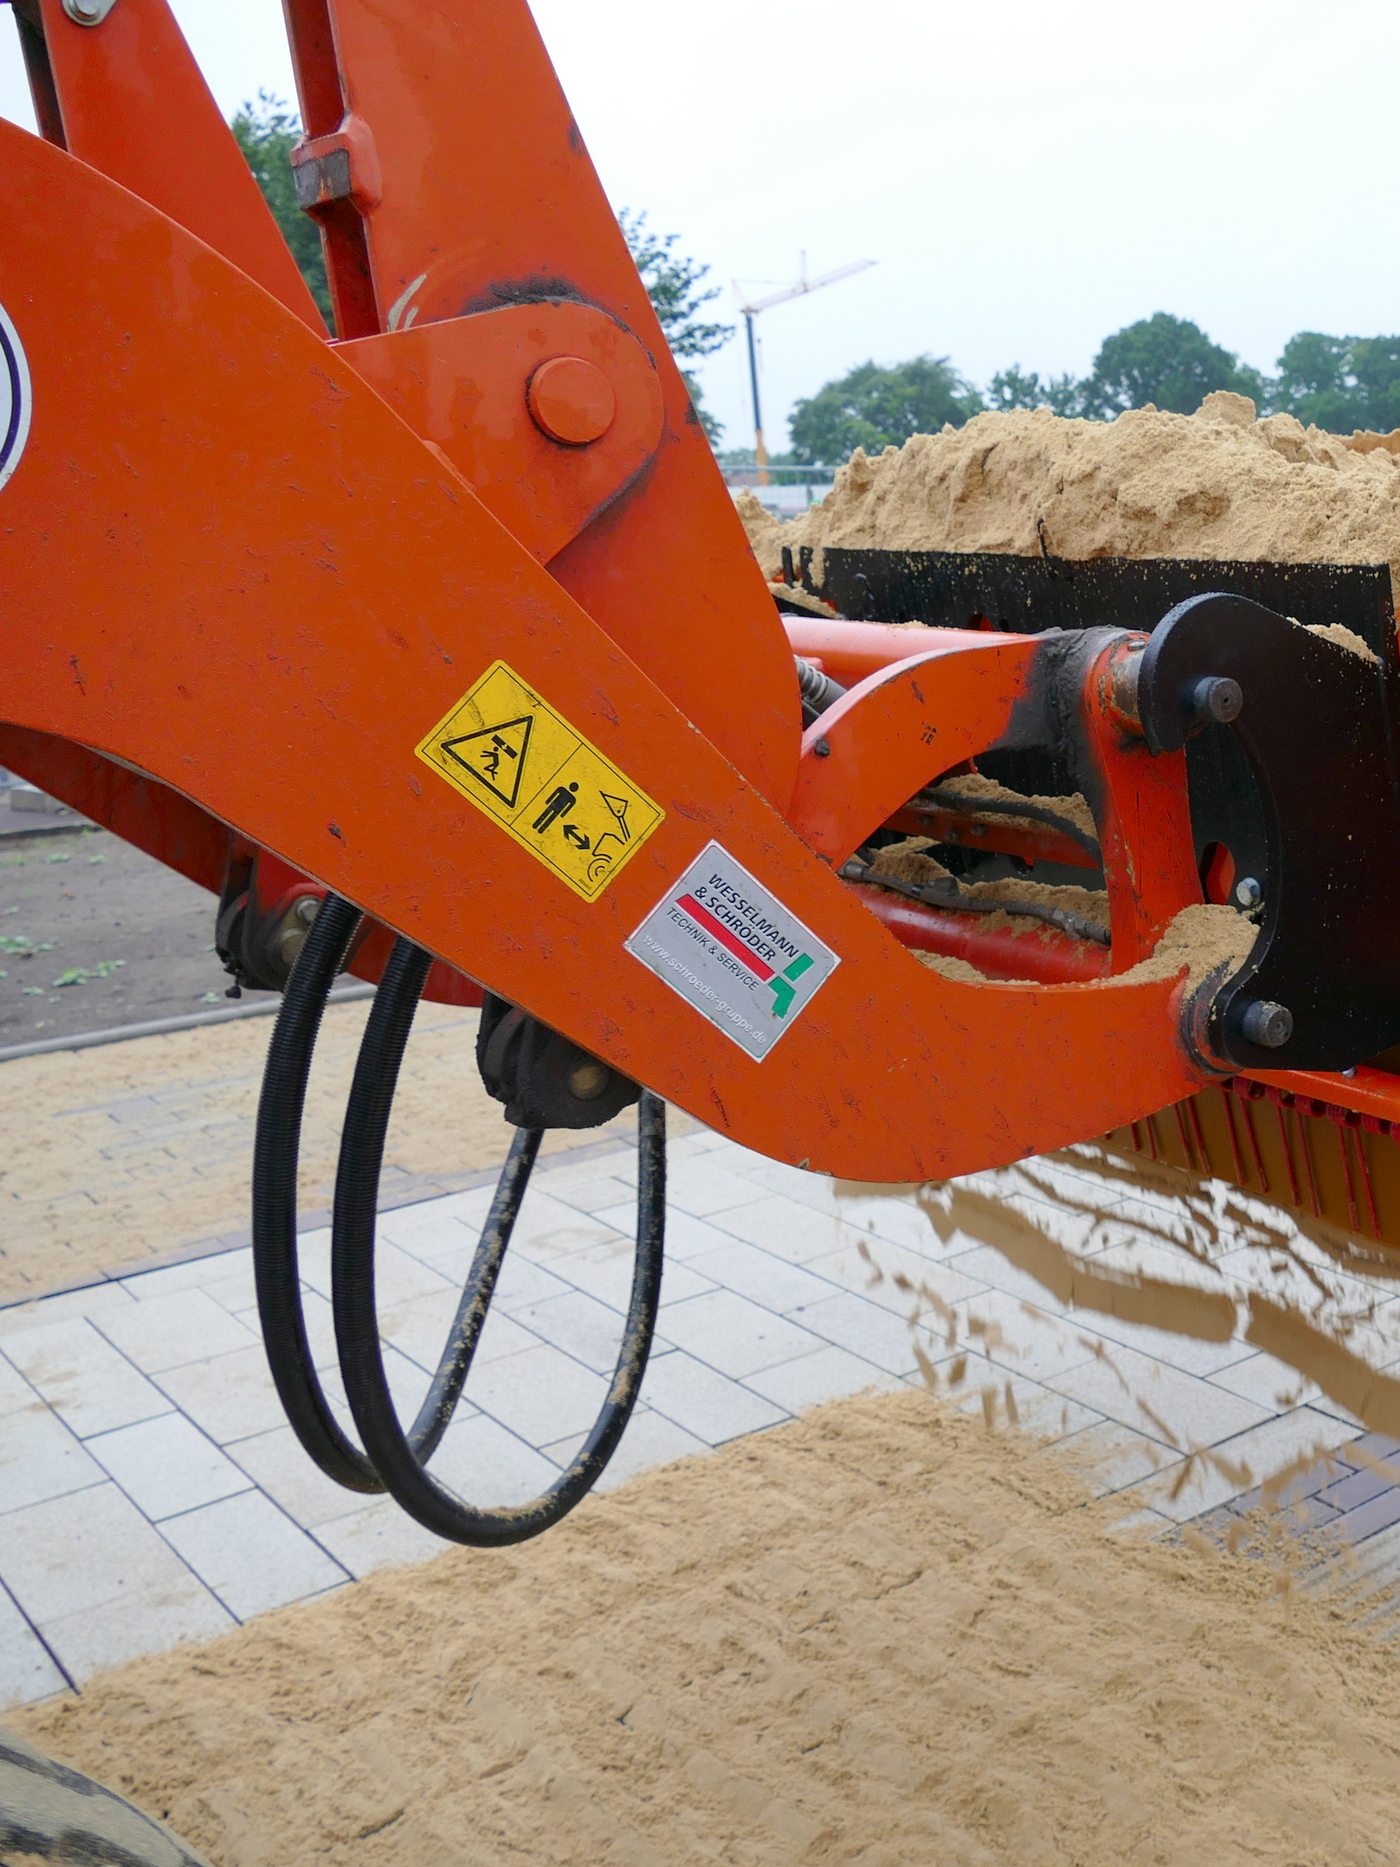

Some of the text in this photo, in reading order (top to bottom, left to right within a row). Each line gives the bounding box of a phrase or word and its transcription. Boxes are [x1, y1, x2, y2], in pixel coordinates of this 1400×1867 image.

[666, 907, 760, 991] TECHNIK & SERVICE
[694, 886, 777, 962] & SCHRÖDER
[708, 873, 799, 959] WESSELMANN
[642, 934, 767, 1045] www.schroeder-gruppe.de
